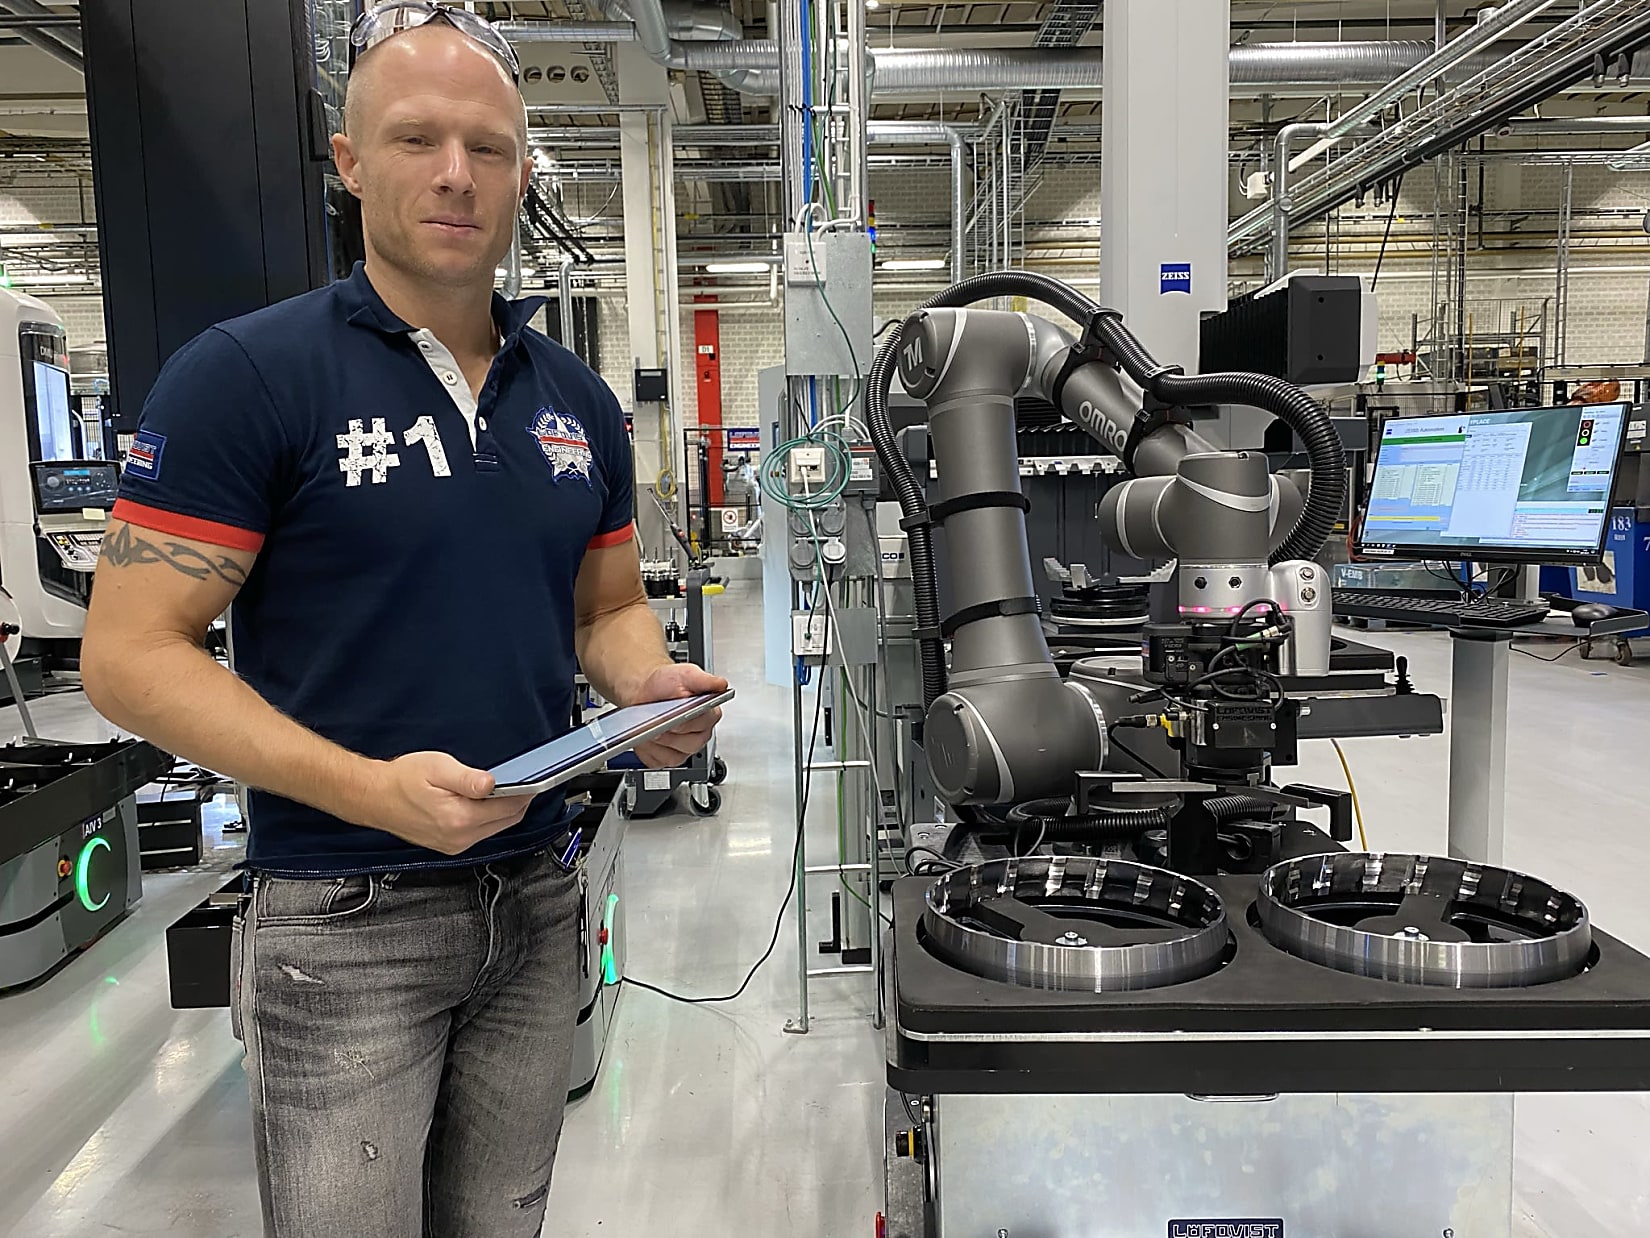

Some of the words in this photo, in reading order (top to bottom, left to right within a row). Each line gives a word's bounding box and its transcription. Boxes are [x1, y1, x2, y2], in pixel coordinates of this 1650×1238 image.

[1161, 271, 1190, 280] ZEISS
[1079, 400, 1128, 452] OMRO
[335, 415, 452, 487] #1
[1611, 515, 1632, 532] 183
[1173, 1224, 1279, 1238] LÖFQVIST
